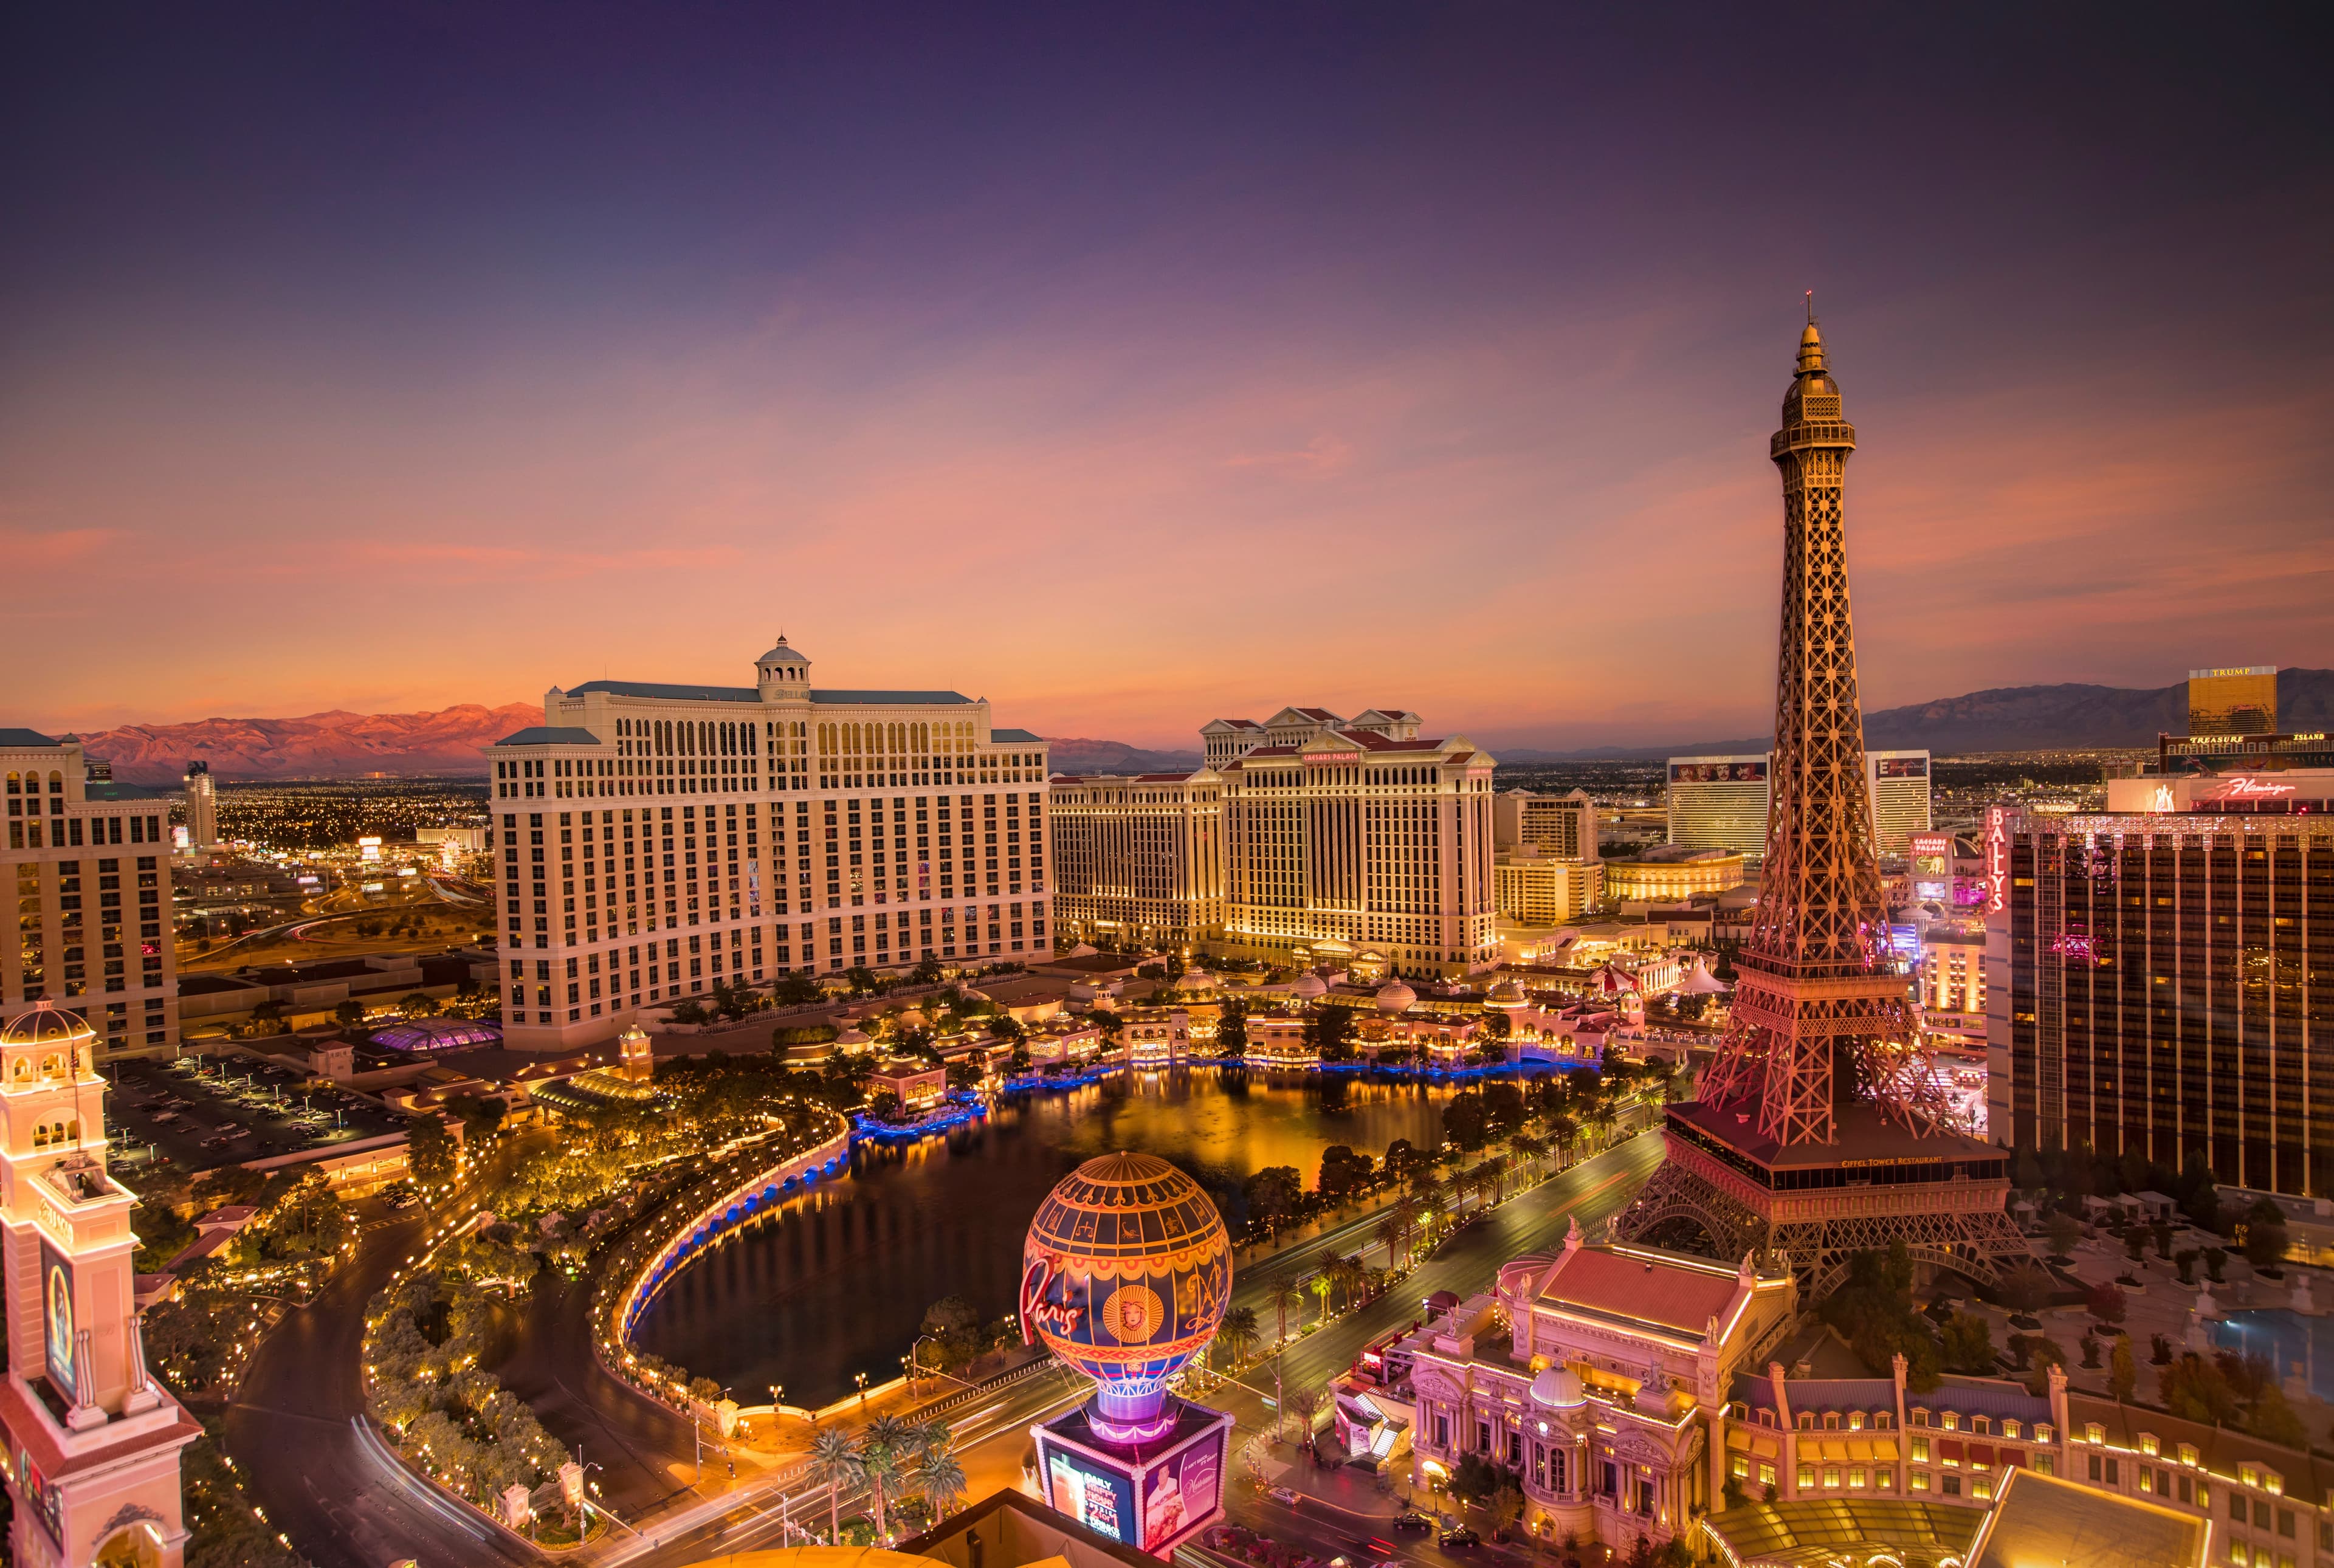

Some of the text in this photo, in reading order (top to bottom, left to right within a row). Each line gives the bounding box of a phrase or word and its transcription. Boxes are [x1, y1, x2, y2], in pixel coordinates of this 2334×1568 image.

[2212, 668, 2251, 676] TRUMP
[2228, 778, 2296, 796] Flamingo
[1019, 1256, 1083, 1346] Paris
[1084, 1472, 1112, 1491] DAILY
[1087, 1483, 1117, 1501] HAPPY
[1090, 1516, 1120, 1537] DRINKS
